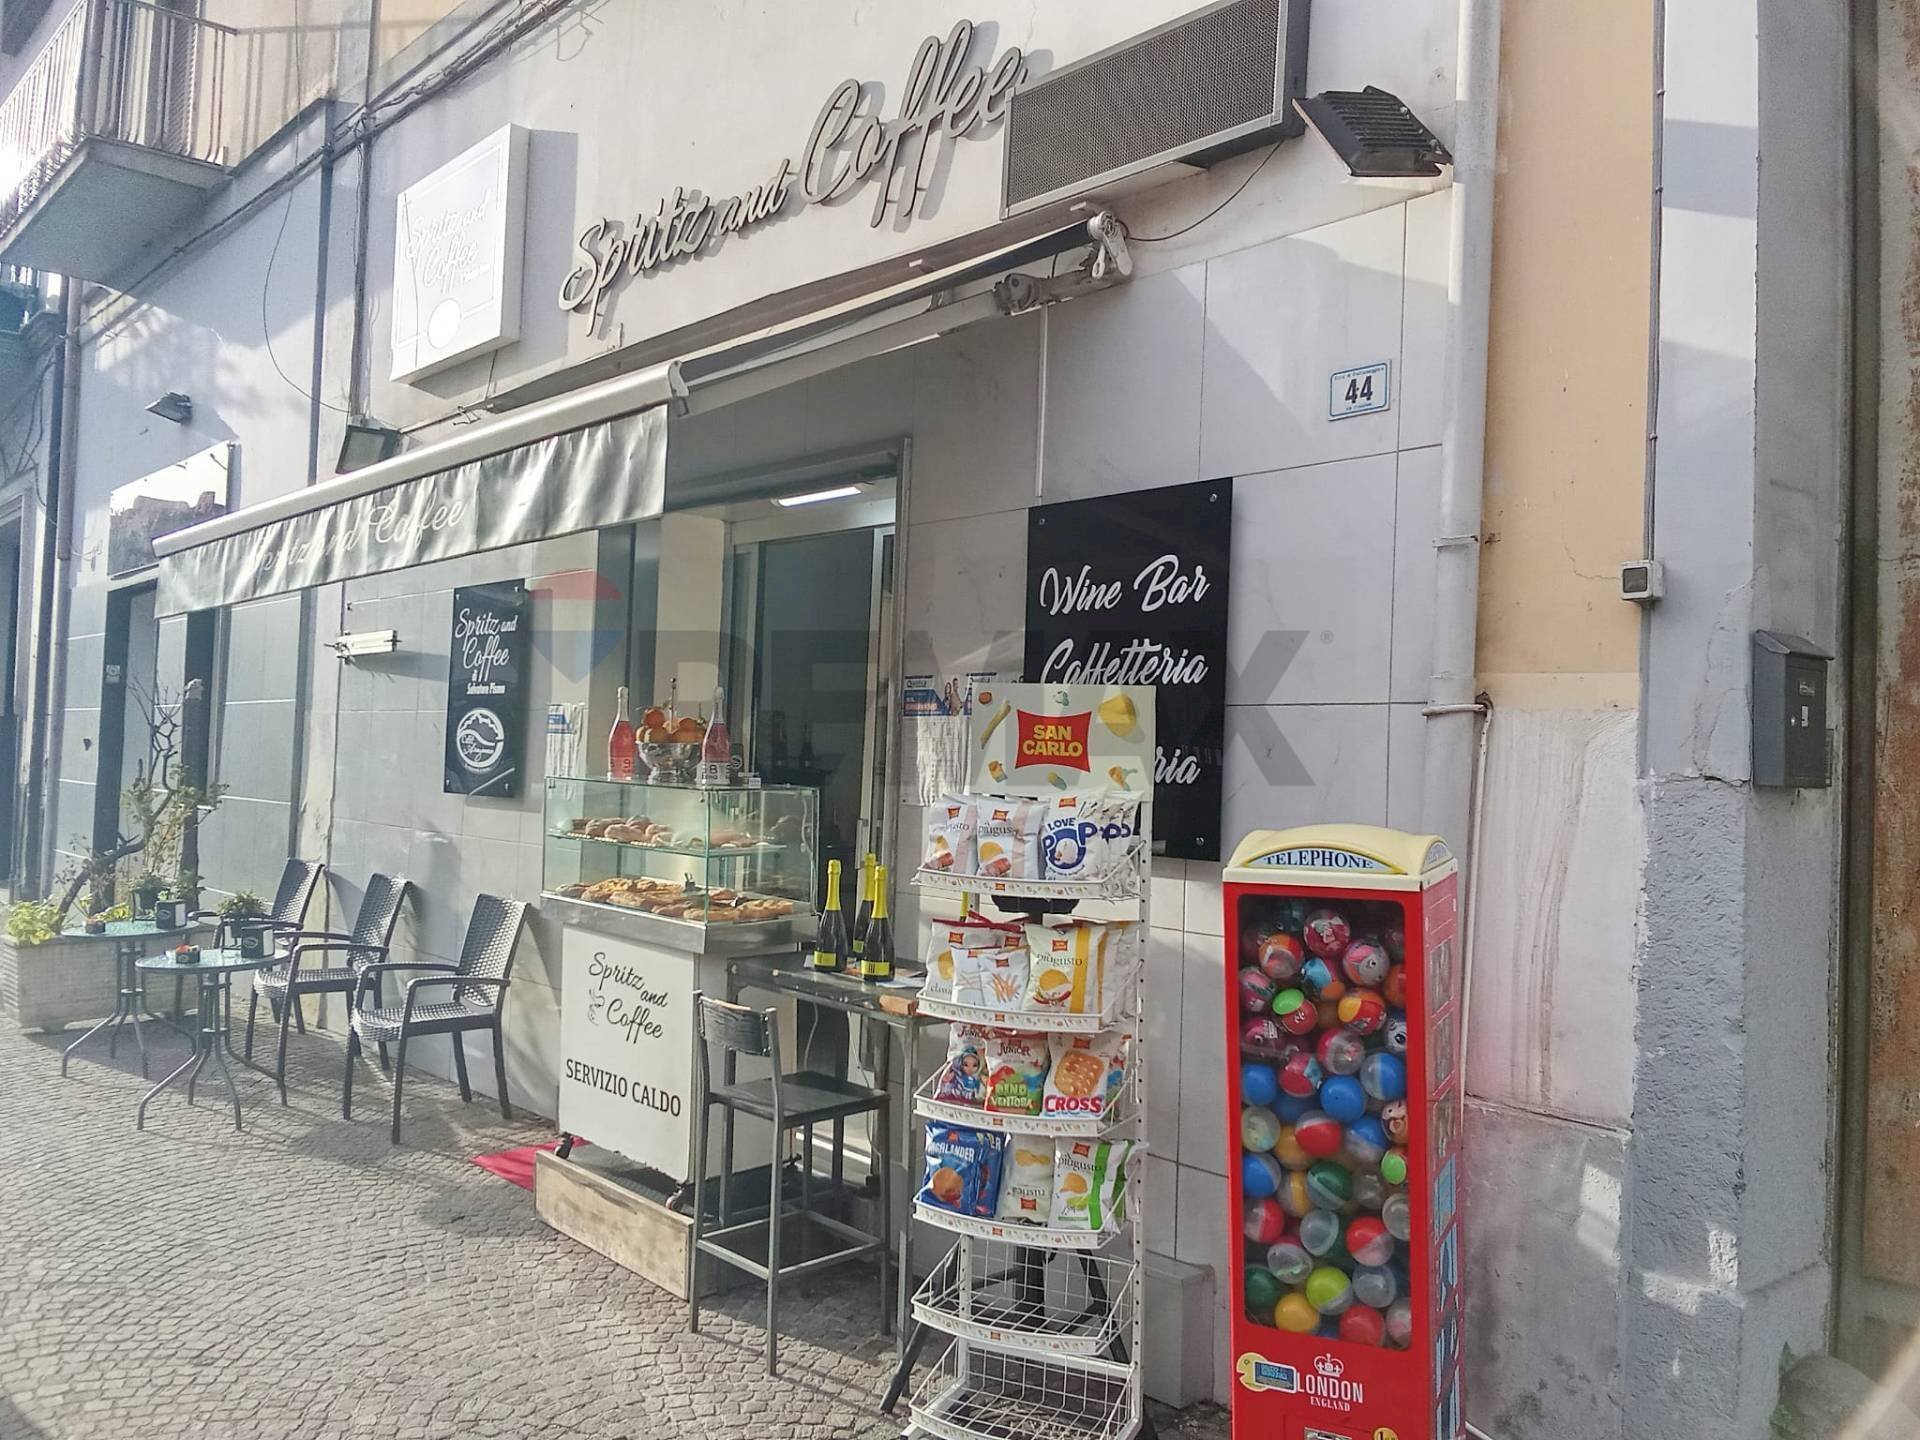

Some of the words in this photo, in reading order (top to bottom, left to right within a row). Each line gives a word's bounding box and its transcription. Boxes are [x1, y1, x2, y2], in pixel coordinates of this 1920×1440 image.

[558, 186, 710, 337] Spritz
[717, 158, 794, 234] and
[800, 19, 1028, 228] Coffee
[1344, 375, 1373, 403] 44
[1039, 564, 1123, 616] Wine
[1133, 554, 1210, 613] Bar
[455, 608, 500, 651] Spritz
[501, 616, 519, 632] and
[463, 635, 510, 682] Coffee
[1033, 724, 1072, 740] SAN
[1022, 740, 1083, 757] CARLO
[1047, 817, 1076, 831] LOVE
[1263, 849, 1374, 869] TELEPHONE
[588, 952, 645, 990] Spritz
[640, 991, 668, 1008] and
[606, 998, 664, 1044] Coffee
[565, 1058, 627, 1098] SERVIZIO
[632, 1081, 682, 1117] CALDO
[1045, 1093, 1105, 1113] CROSS
[1296, 1373, 1363, 1403] LONDON
[1310, 1396, 1351, 1412] ENGLAND
